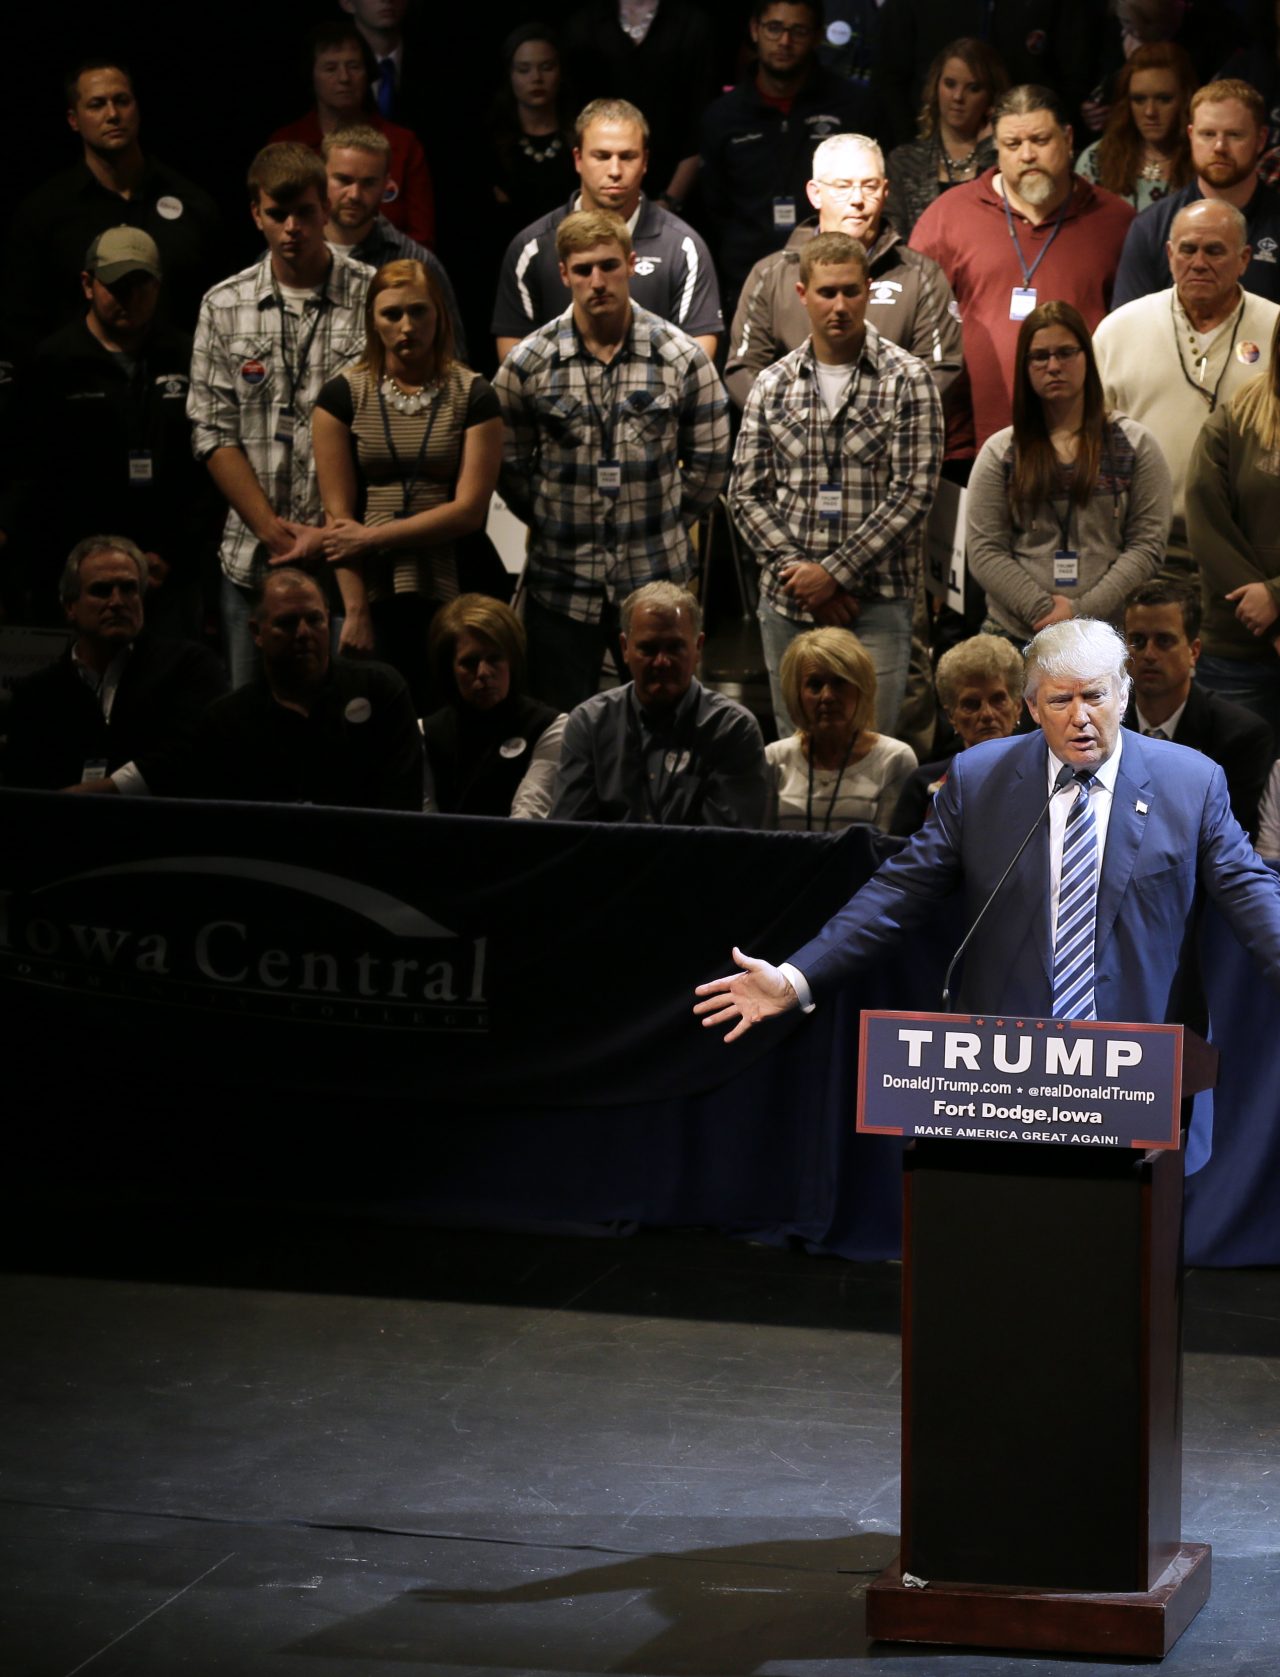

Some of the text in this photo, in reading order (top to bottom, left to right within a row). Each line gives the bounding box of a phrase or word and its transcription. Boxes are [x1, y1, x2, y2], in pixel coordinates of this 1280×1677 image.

[194, 919, 489, 1004] Central
[15, 961, 250, 1010] OMMUNITY
[898, 1028, 1144, 1078] TRUMP
[882, 1073, 1155, 1105] DonaldJTrump.com @realDonaldTrump
[933, 1100, 1103, 1124] Fort Dodge,Iowa
[914, 1125, 1119, 1146] MAKE AMERICA GREAT AGAIN!
